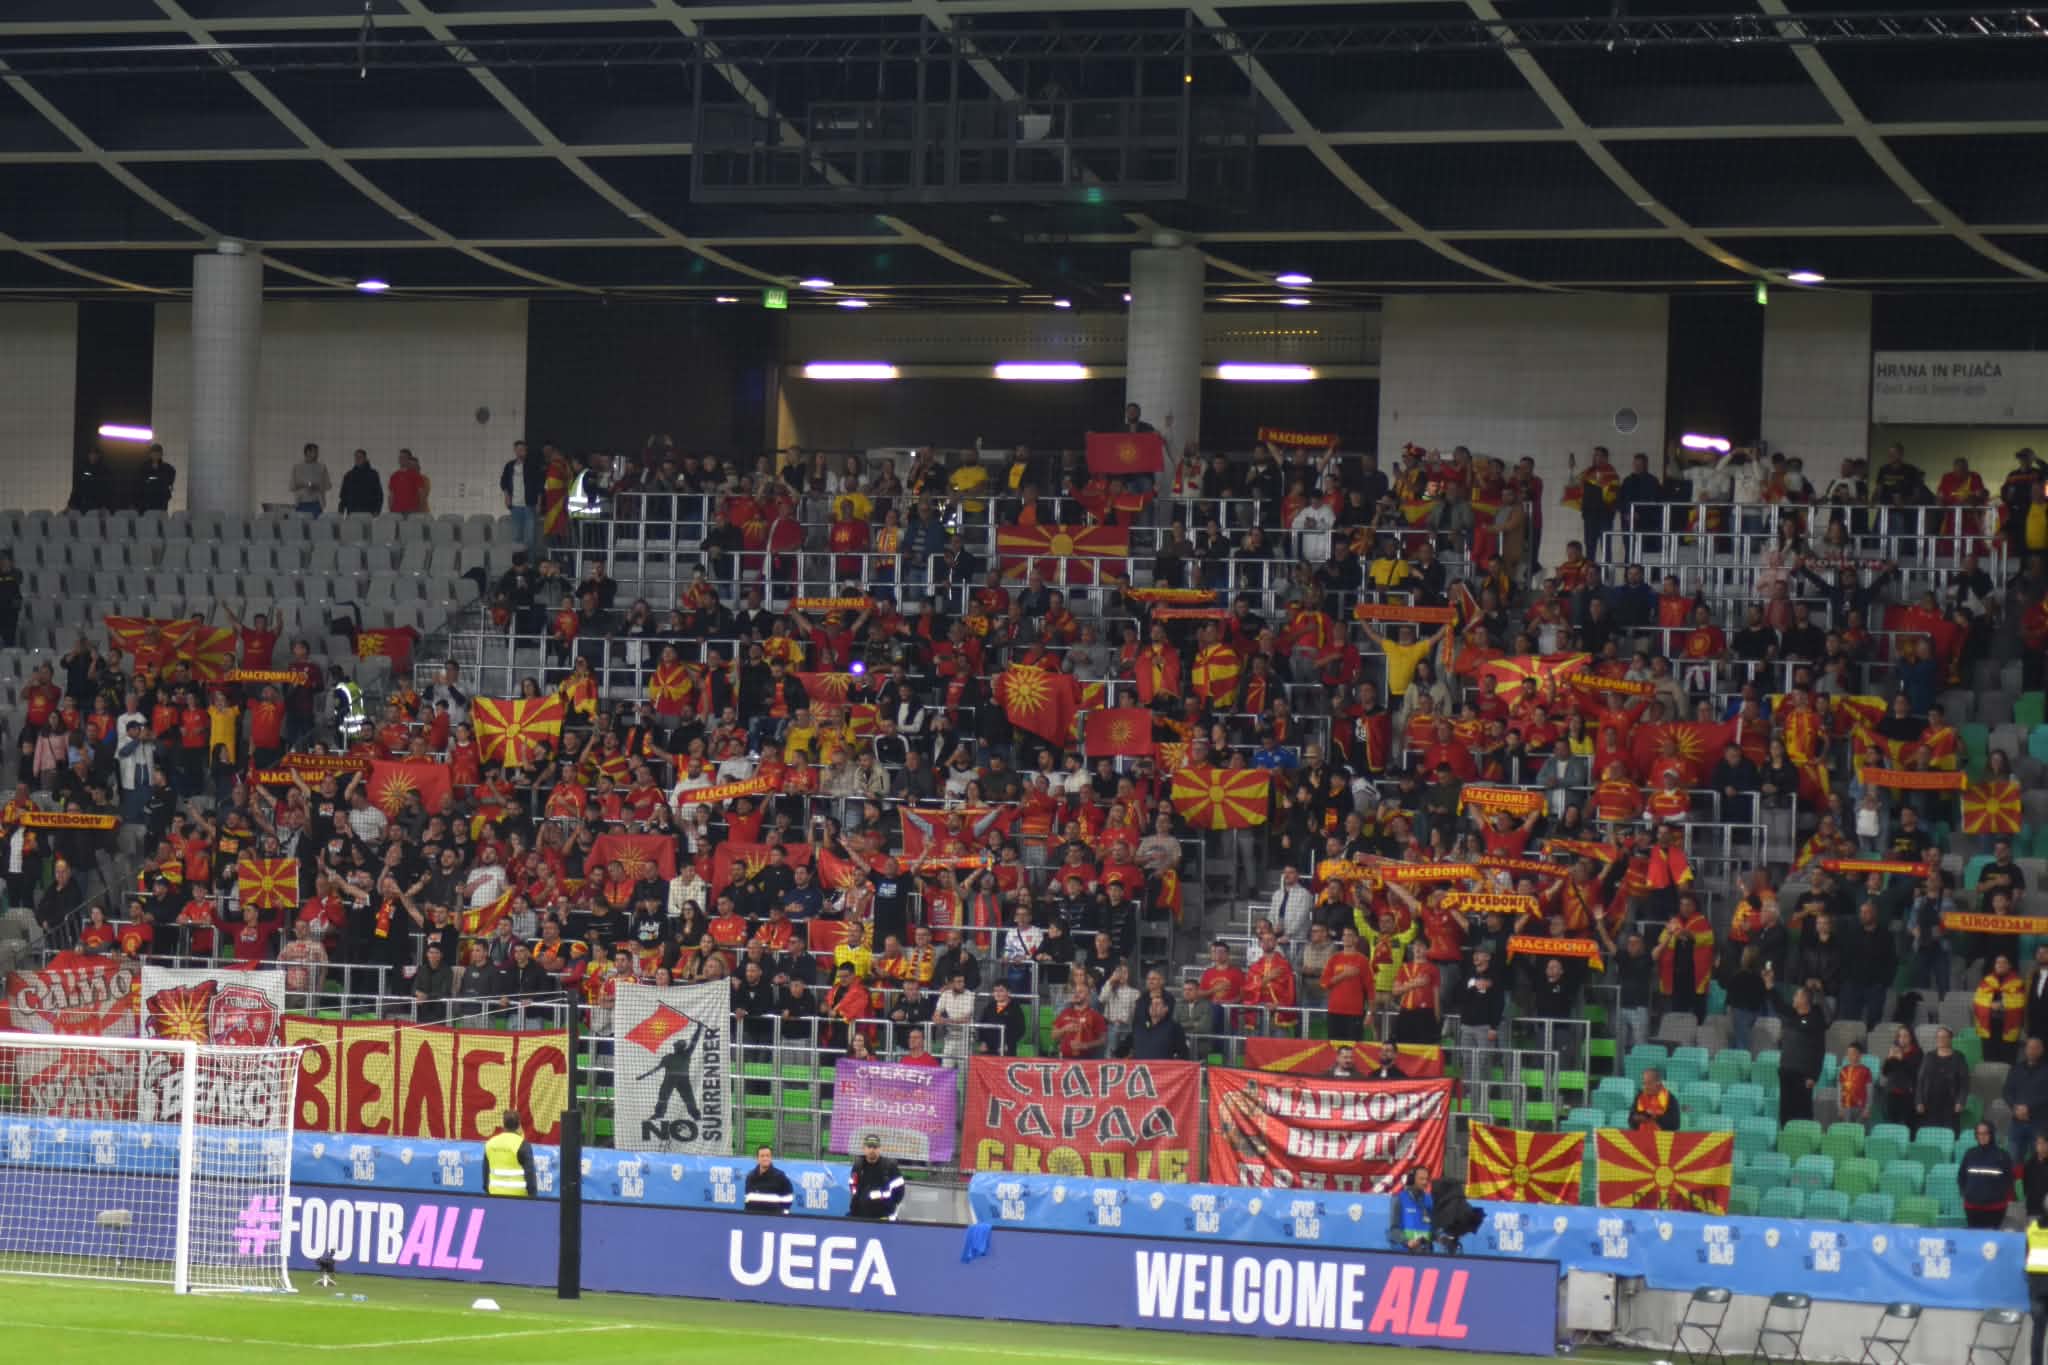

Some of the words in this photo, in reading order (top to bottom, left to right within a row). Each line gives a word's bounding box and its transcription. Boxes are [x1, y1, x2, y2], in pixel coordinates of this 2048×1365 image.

[1877, 363, 1927, 377] HRANA
[1931, 363, 1948, 377] IN
[695, 778, 767, 801] MACEDONIA
[1397, 864, 1473, 878] MACEDONIA
[1511, 938, 1597, 953] MACEDONIA
[292, 1037, 567, 1145] ВЕЛЕС
[702, 1027, 723, 1142] SURRENDER
[1006, 1061, 1159, 1100] СТАРА
[985, 1094, 1179, 1146] ГАРДА
[1264, 1086, 1445, 1121] МАРКОВИ
[641, 1119, 699, 1143] NO
[1287, 1127, 1419, 1164] ВНУЦИ
[233, 1195, 486, 1271] #FOOTBALL
[729, 1229, 897, 1296] UEFA
[1136, 1250, 1366, 1331] WELCOME
[1368, 1266, 1470, 1339] ALL
